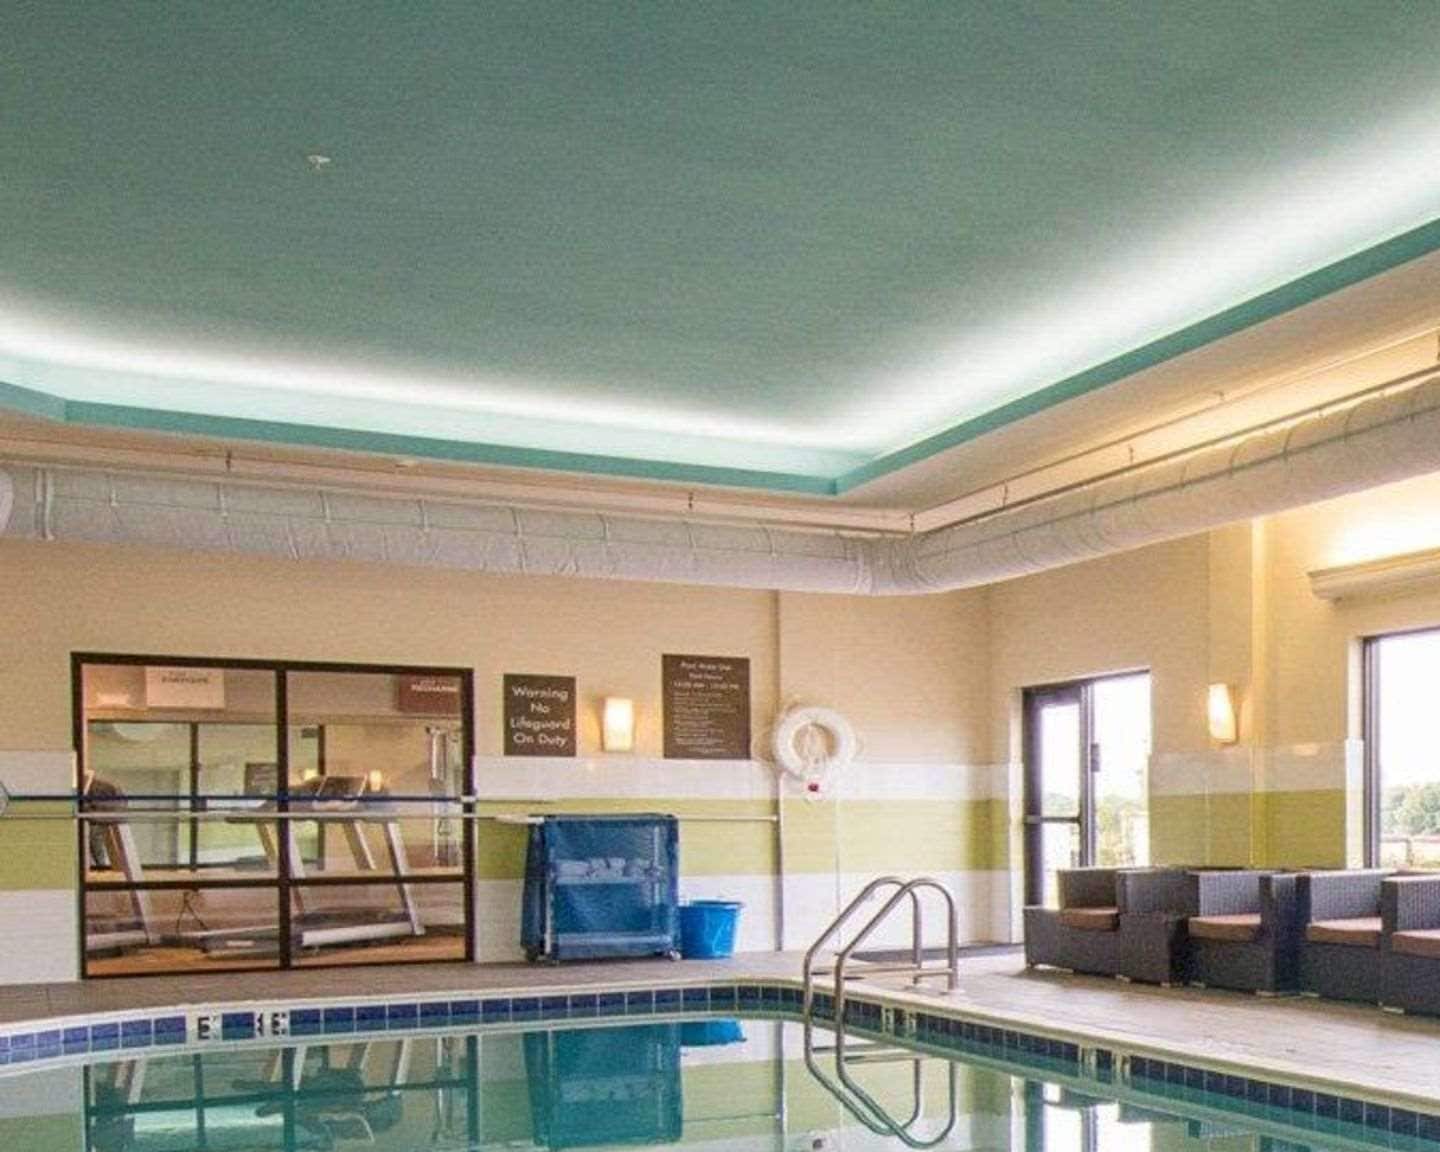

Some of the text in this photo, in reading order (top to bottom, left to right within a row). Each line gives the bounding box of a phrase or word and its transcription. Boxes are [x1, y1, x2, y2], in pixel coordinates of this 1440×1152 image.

[511, 685, 569, 702] Warning
[530, 703, 551, 714] No
[510, 716, 571, 732] Lifeguard
[512, 731, 568, 748] On Duty
